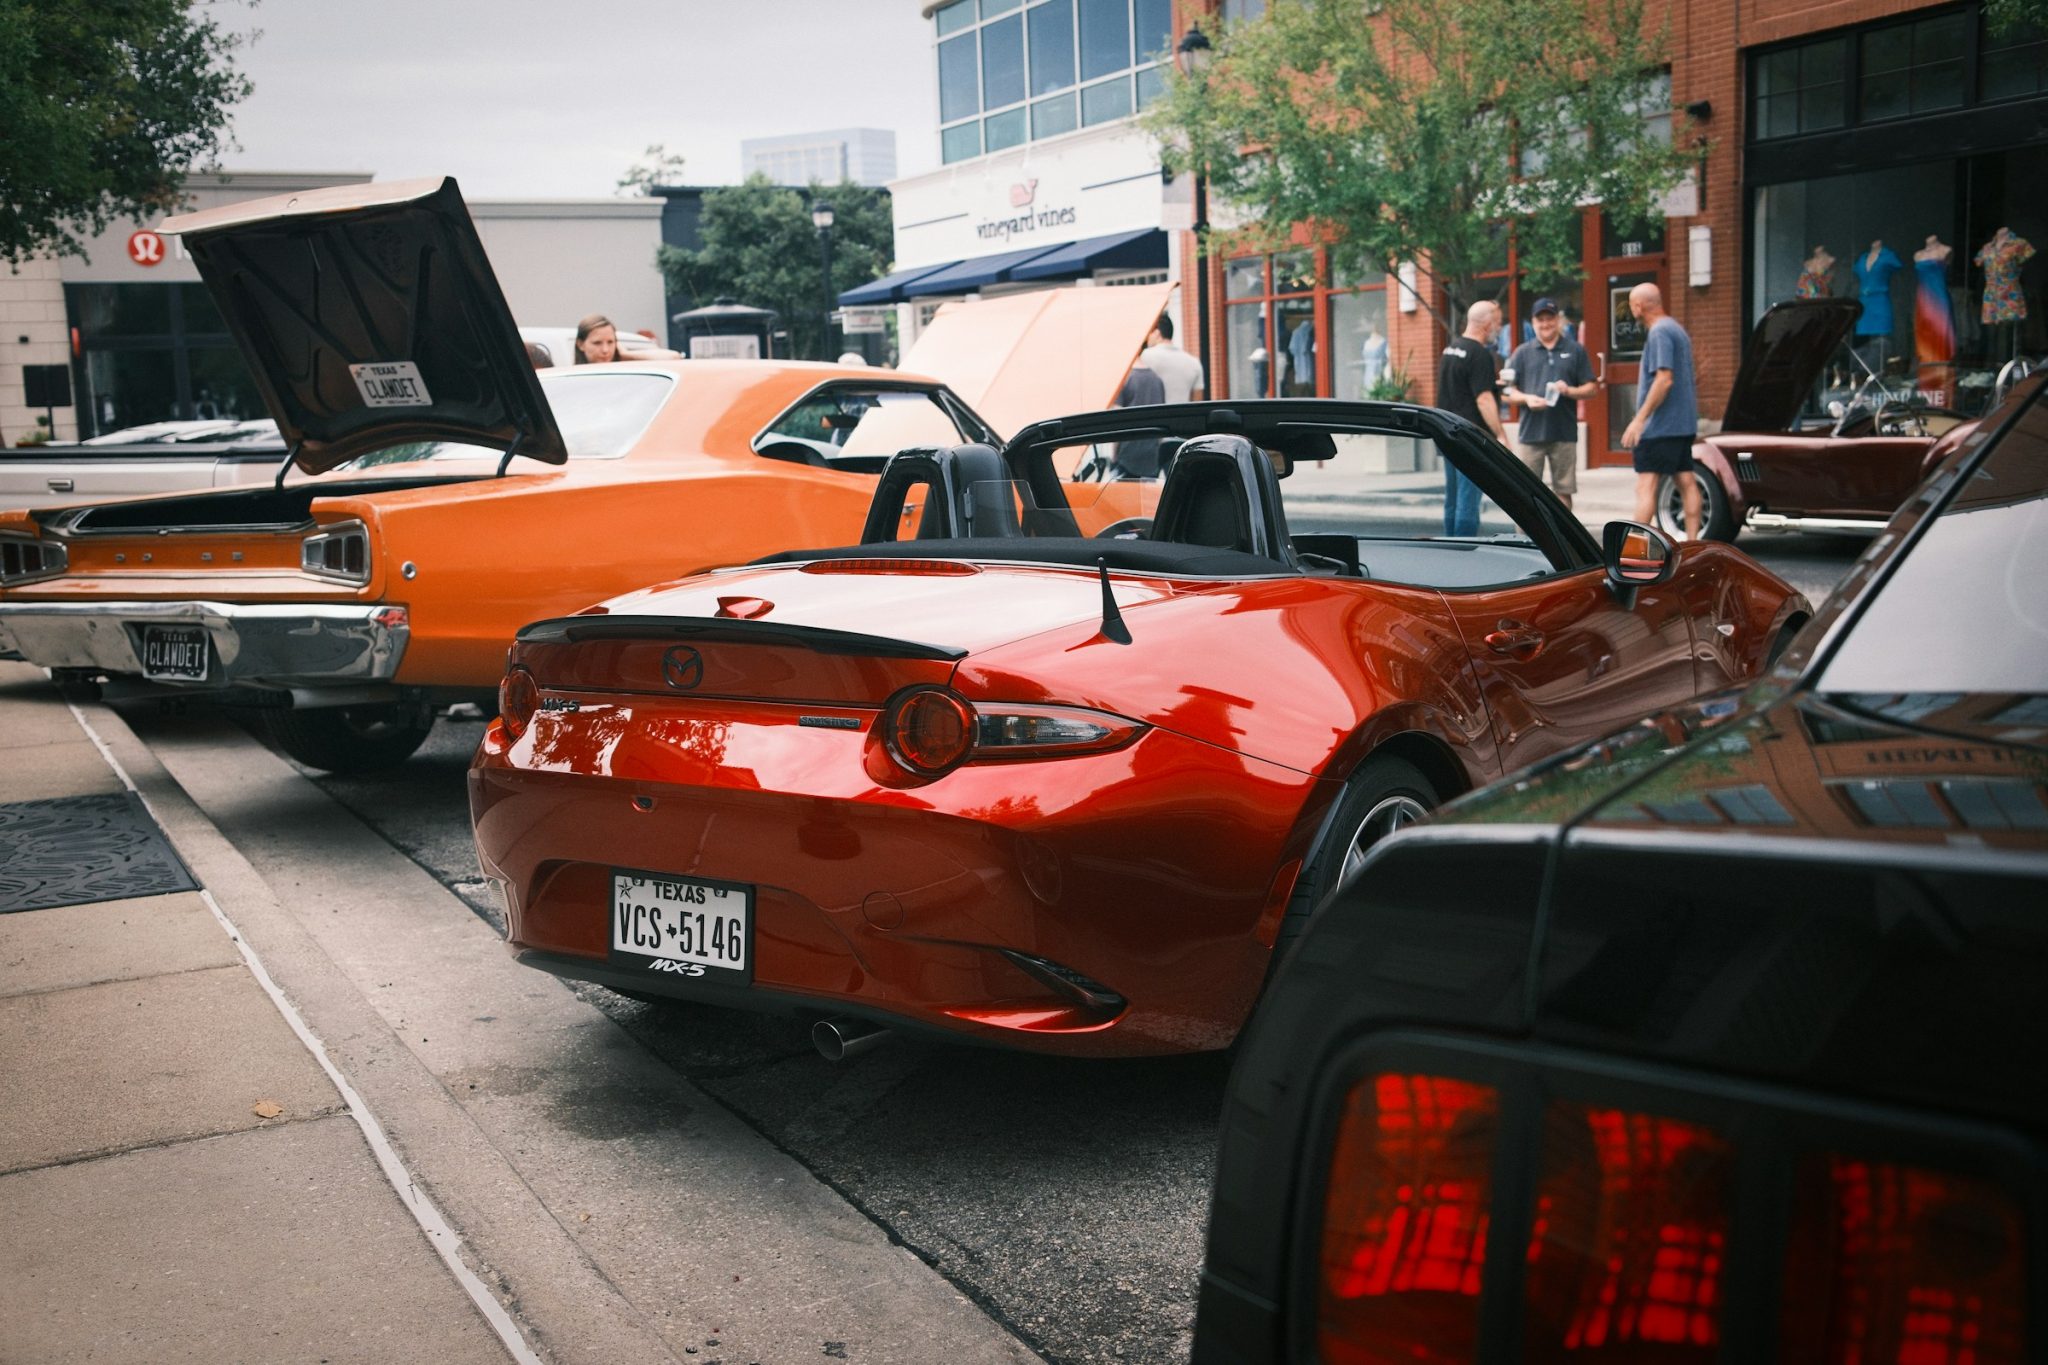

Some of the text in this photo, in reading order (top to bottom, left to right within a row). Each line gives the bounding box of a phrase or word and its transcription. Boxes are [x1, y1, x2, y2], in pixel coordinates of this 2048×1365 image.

[977, 203, 1076, 243] vineyard vines
[371, 366, 397, 375] TEXAS
[364, 377, 419, 399] CLANDET
[163, 632, 188, 642] TEXAS
[149, 642, 201, 668] CLANDET
[653, 881, 706, 905] TEXAS
[619, 902, 742, 962] VCS 5146
[648, 958, 707, 977] MX-5
